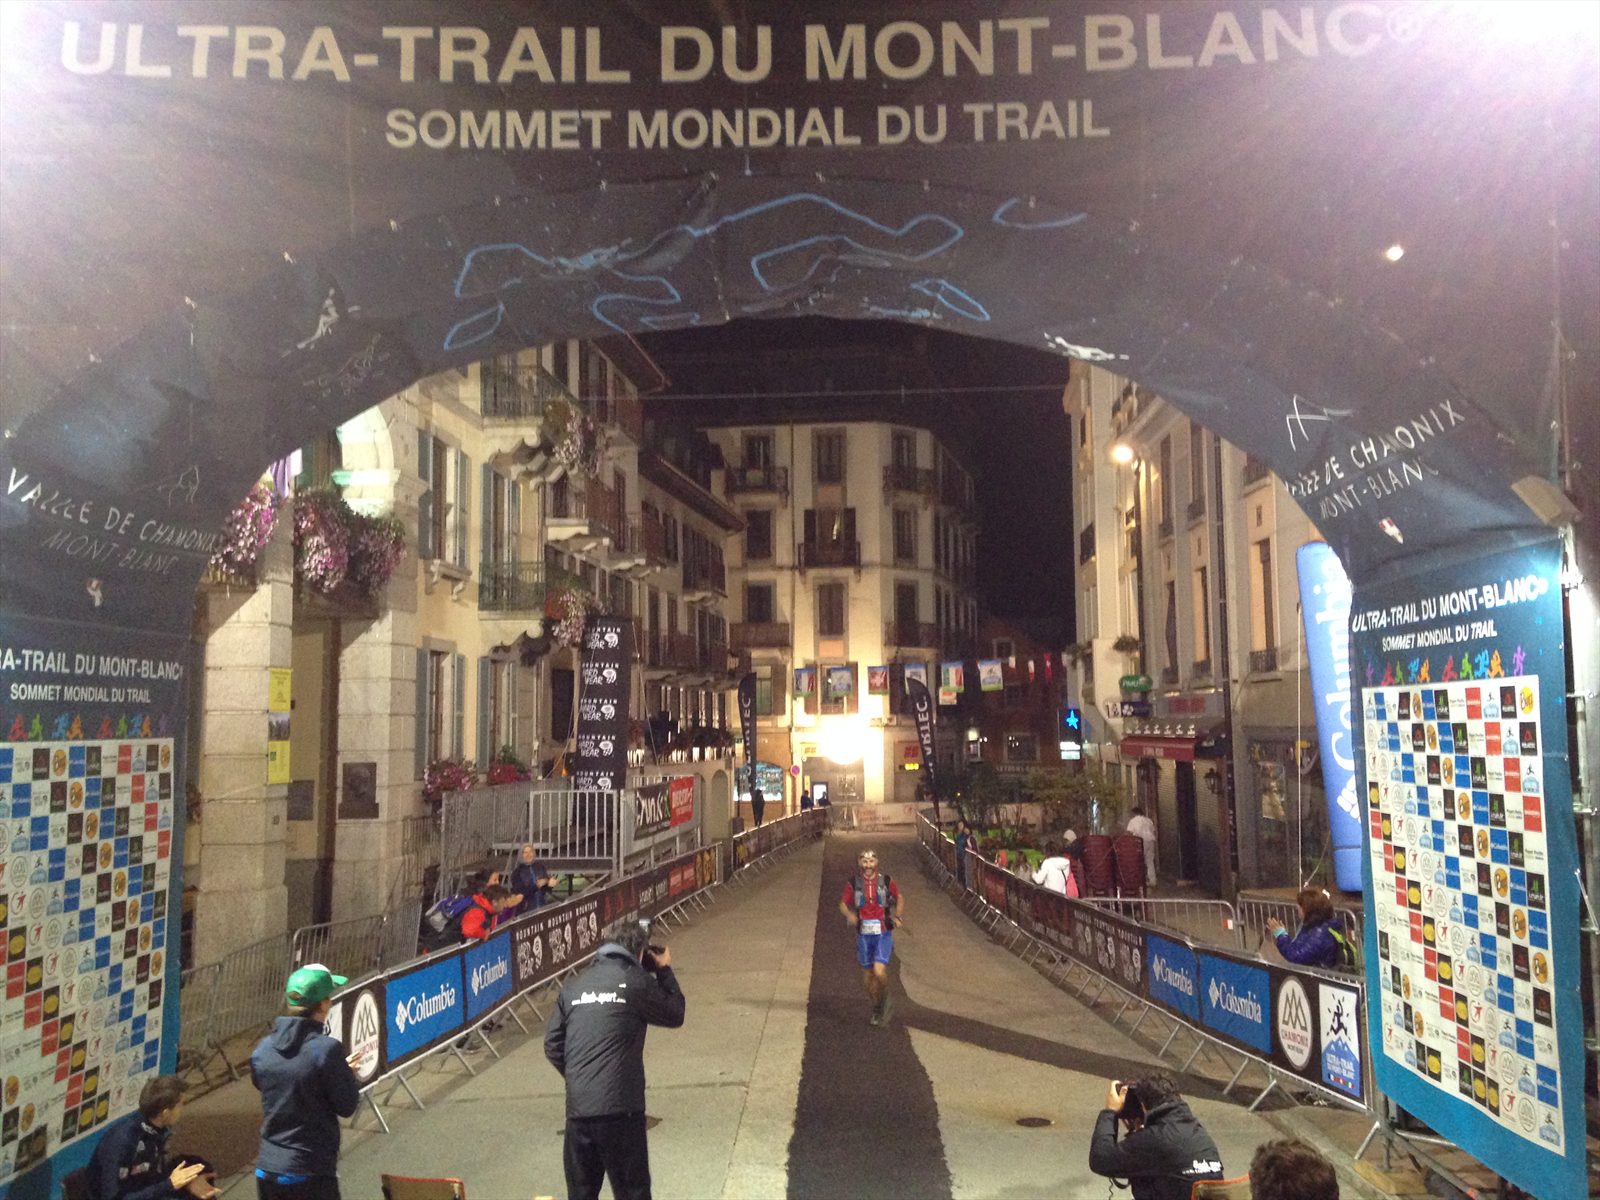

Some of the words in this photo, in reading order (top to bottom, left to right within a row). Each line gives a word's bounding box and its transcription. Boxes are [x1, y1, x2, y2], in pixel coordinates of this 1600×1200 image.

[60, 22, 631, 83] ULTRA-TRAIL
[660, 24, 773, 83] DU
[385, 108, 611, 150] SOMMET
[627, 106, 862, 149] MONDIAL
[876, 103, 948, 145] DU
[963, 99, 1111, 142] TRAIL
[1324, 455, 1345, 486] DE
[103, 506, 135, 535] DE
[1351, 605, 1420, 633] ULTRA-TRAIL
[1421, 597, 1436, 620] DU
[1382, 633, 1416, 653] SOMMET
[1416, 626, 1454, 647] MONDIAL
[1455, 624, 1470, 643] DU
[1471, 619, 1498, 640] TRAIL
[74, 653, 97, 676] DU
[10, 682, 62, 701] SOMMET
[64, 685, 110, 702] MONDIAL
[111, 688, 126, 703] DU
[127, 688, 151, 704] TRAIL
[478, 954, 508, 990] Columbia
[1160, 957, 1194, 997] Columbia
[406, 982, 456, 1026] Columbia
[1219, 981, 1263, 1024] Columbia
